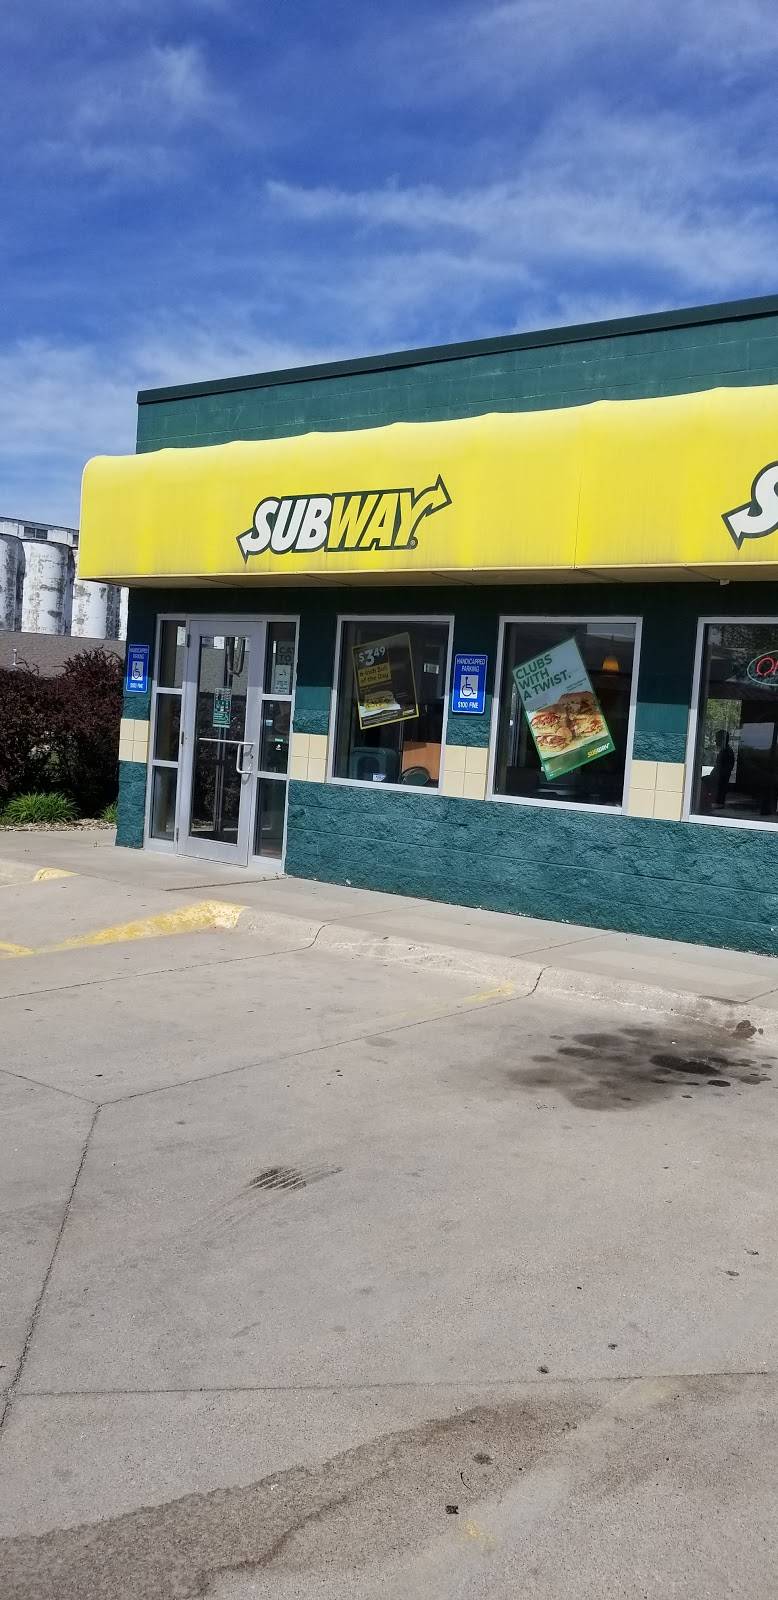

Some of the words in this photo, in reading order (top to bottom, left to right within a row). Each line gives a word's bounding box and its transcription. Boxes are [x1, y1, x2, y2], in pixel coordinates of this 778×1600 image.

[236, 474, 452, 564] SUBWAY
[456, 657, 486, 665] HANDICAPPED
[461, 665, 480, 673] PARKING
[515, 654, 553, 679] CLUBS
[518, 668, 549, 690] WITH
[524, 690, 532, 701] A
[532, 669, 571, 695] TWIST.
[457, 701, 468, 709] $100
[469, 701, 479, 709] FINE
